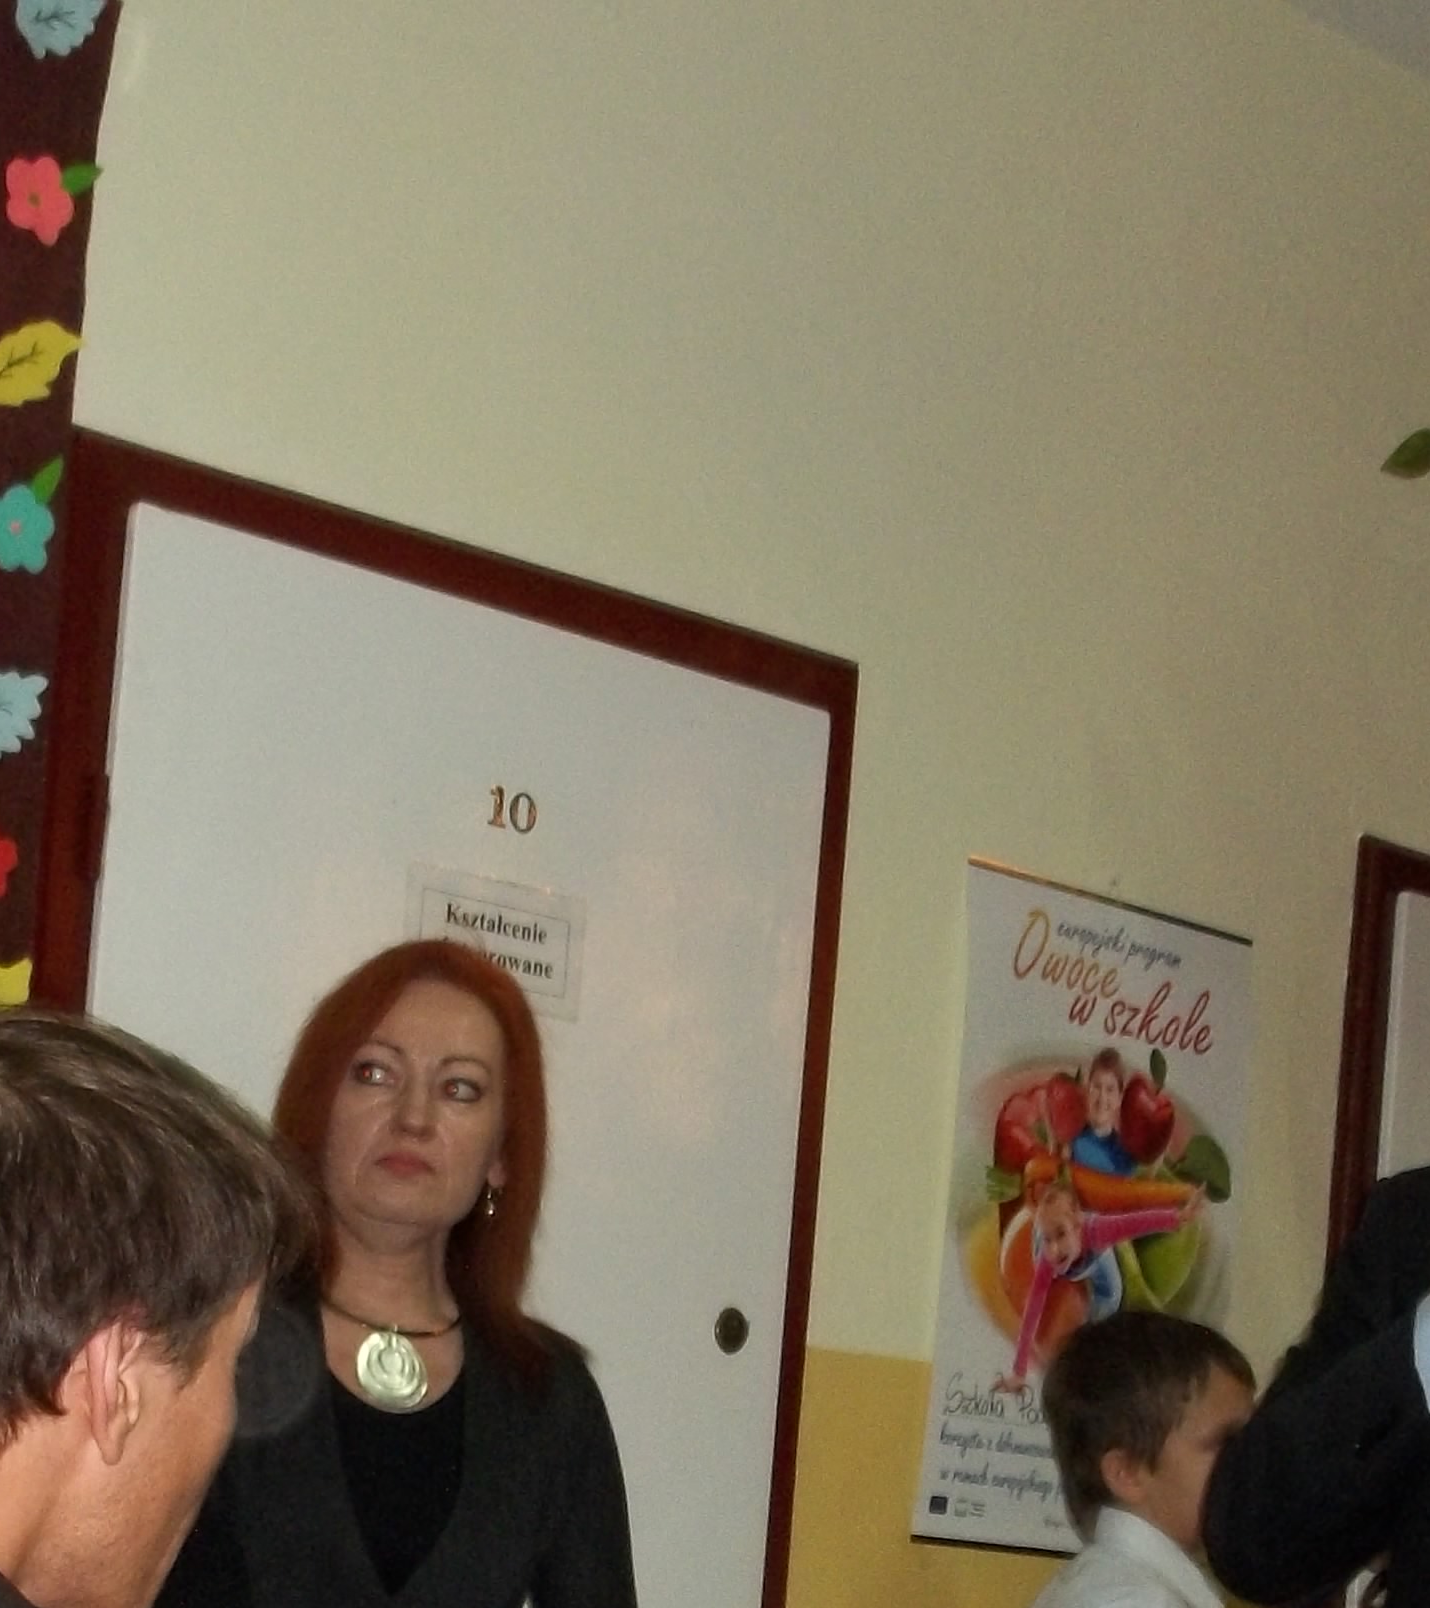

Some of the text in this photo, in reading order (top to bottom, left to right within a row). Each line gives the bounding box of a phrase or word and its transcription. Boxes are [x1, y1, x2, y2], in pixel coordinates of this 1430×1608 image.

[487, 785, 538, 834] 10
[446, 903, 548, 945] Kształcenie
[1013, 909, 1121, 999] Owoce
[1068, 980, 1214, 1055] w szkole
